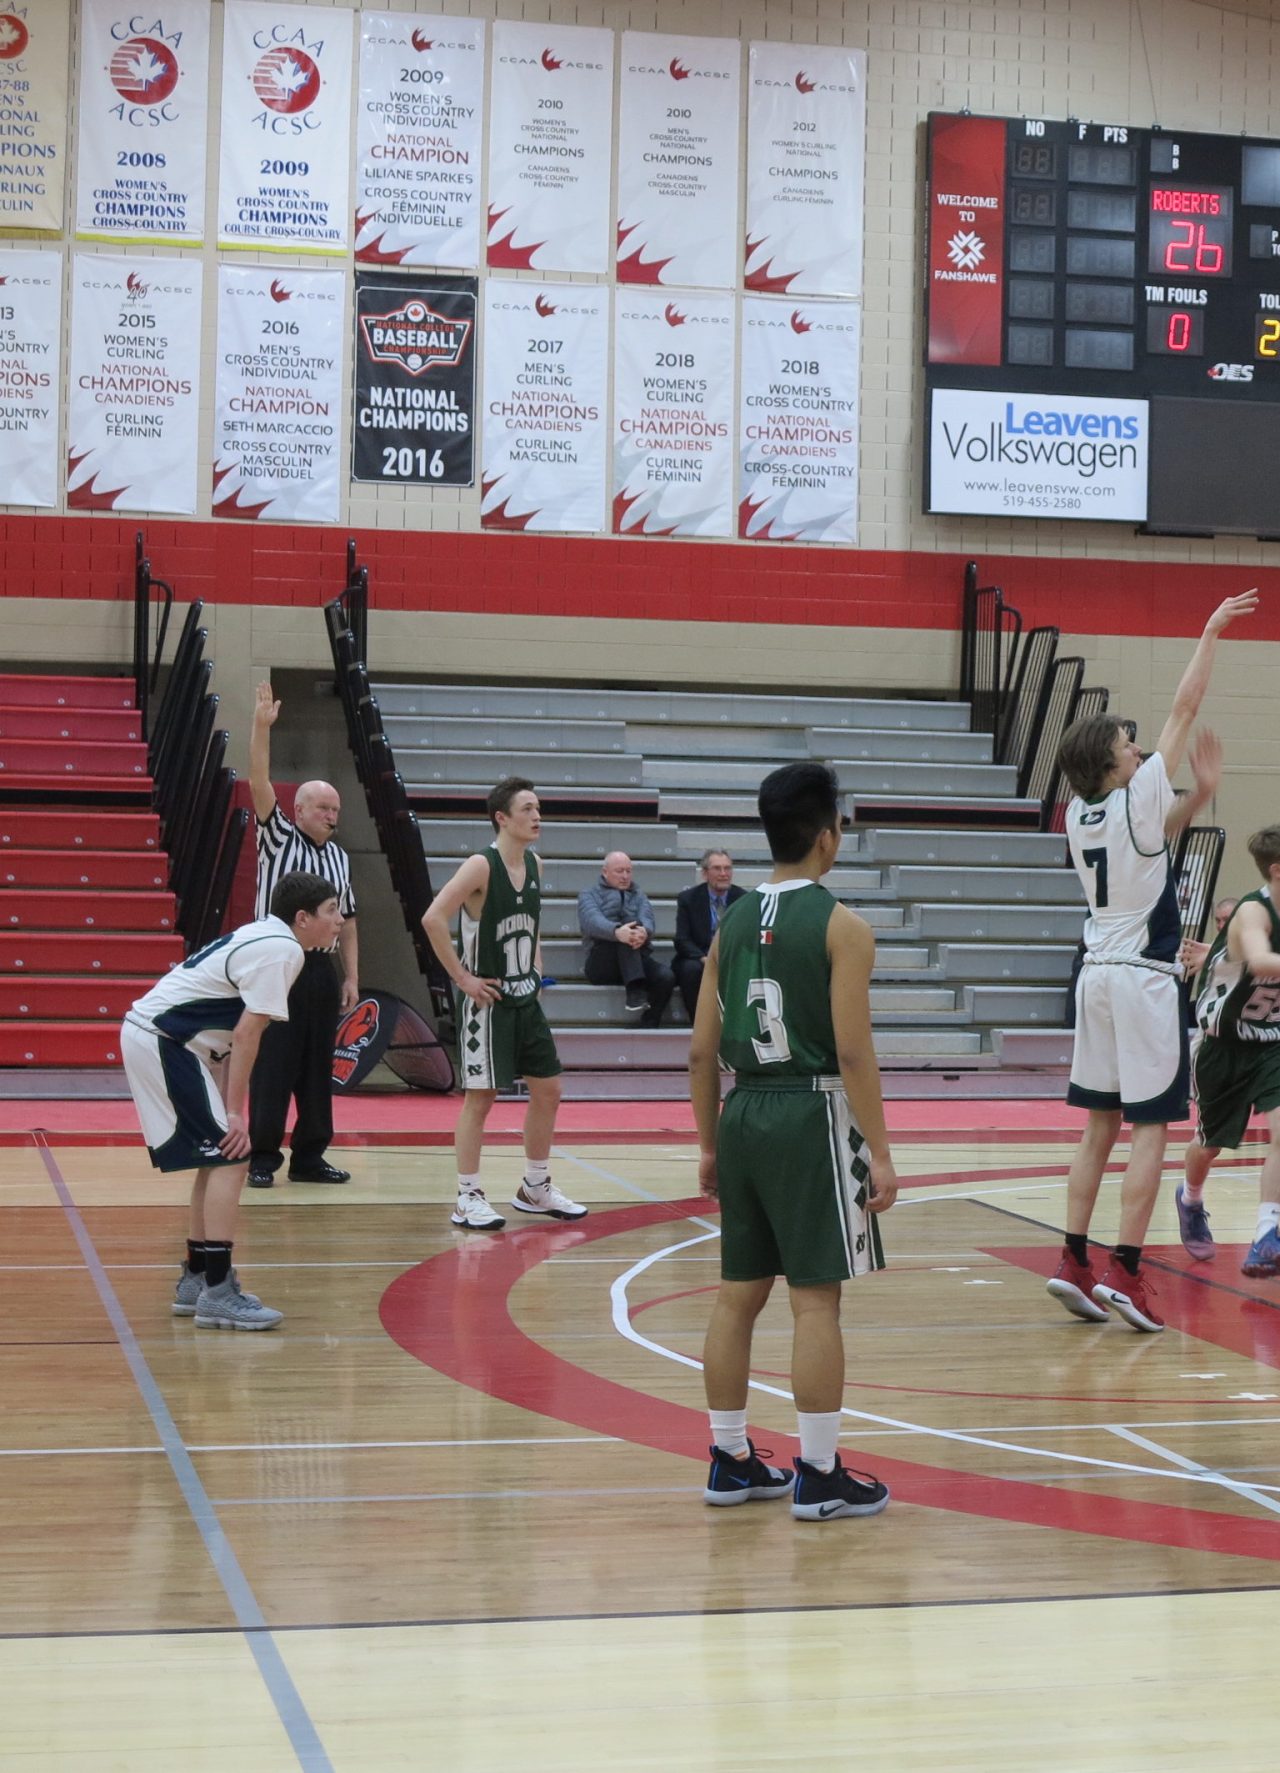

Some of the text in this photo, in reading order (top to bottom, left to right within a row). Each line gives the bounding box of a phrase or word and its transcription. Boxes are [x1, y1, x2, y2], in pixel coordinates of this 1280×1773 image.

[400, 69, 444, 83] 2009
[390, 91, 452, 105] WOMEN'S
[538, 99, 563, 110] 2010
[367, 102, 474, 119] CROSS COUNTRY
[667, 108, 692, 118] 2010
[383, 115, 457, 129] INDIVIDUAL
[792, 122, 816, 132] 2012
[1026, 121, 1045, 137] NO
[1079, 126, 1086, 139] F
[1104, 127, 1128, 143] PTS
[387, 134, 452, 147] NATIONAL
[371, 145, 469, 164] CHAMPION
[514, 144, 585, 158] CHAMPIONS
[1173, 145, 1179, 156] B
[117, 152, 166, 168] 2008
[643, 153, 712, 166] CHAMPIONS
[1173, 158, 1179, 169] B
[260, 160, 309, 176] 2009
[769, 167, 838, 180] CHAMPIONS
[365, 168, 473, 184] LILIANE SPARKES
[115, 179, 166, 191] WOMEN'S
[93, 189, 188, 203] CROSS COUNTRY
[258, 187, 309, 198] WOMEN'S
[365, 188, 472, 203] CROSS COUNTRY
[237, 197, 329, 211] CROSS COUNTRY
[937, 194, 998, 208] WELCOME
[1153, 190, 1220, 215] ROBERTS
[95, 202, 185, 218] CHAMPIONS
[959, 211, 975, 222] TO
[238, 210, 328, 226] CHAMPIONS
[374, 213, 463, 227] INDIVIDUELLE
[1272, 231, 1278, 241] P
[1165, 221, 1224, 273] 26
[934, 270, 996, 283] FANSHAWE
[1145, 286, 1207, 304] TM FOULS
[118, 314, 155, 328] 2015
[262, 320, 299, 334] 2016
[373, 328, 458, 348] BASEBALL
[1168, 314, 1191, 350] 0
[1260, 319, 1280, 356] 2
[104, 334, 168, 347] WOMEN'S
[528, 339, 563, 353] 2017
[107, 347, 164, 360] CURLING
[259, 344, 300, 356] MEN'S
[225, 354, 334, 370] CROSS COUNTRY
[525, 362, 565, 373] MEN'S
[656, 353, 694, 368] 2018
[781, 360, 819, 375] 2018
[102, 364, 168, 377] NATIONAL
[241, 367, 317, 380] INDIVIDUAL
[1214, 363, 1254, 381] OES
[79, 376, 191, 394] CHAMPIONS
[516, 374, 572, 386] CURLING
[643, 378, 707, 390] WOMEN'S
[245, 386, 312, 399] NATIONAL
[370, 386, 459, 410] NATIONAL
[512, 390, 576, 403] NATIONAL
[647, 391, 703, 403] CURLING
[769, 385, 831, 397] WOMEN'S
[95, 392, 174, 406] CANADIENS
[746, 396, 854, 412] CROSS COUNTRY
[229, 398, 328, 416] CHAMPION
[490, 402, 598, 420] CHAMPIONS
[105, 413, 163, 426] CURLING
[360, 408, 468, 432] CHAMPIONS
[641, 409, 707, 420] NATIONAL
[767, 415, 830, 427] NATIONAL
[1007, 402, 1138, 439] Leavens
[223, 421, 333, 435] SETH MARCACCIO
[505, 419, 582, 432] CANADIENS
[620, 420, 728, 436] CHAMPIONS
[746, 426, 852, 443] CHAMPIONS
[223, 440, 331, 456] CROSS COUNTRY
[516, 439, 571, 450] CURLING
[636, 438, 712, 451] CANADIENS
[761, 445, 837, 457] CANADIENS
[943, 422, 1136, 477] Volkswagen
[243, 455, 312, 468] MASCULIN
[382, 447, 444, 477] 2016
[510, 452, 577, 463] MASCULIN
[646, 457, 703, 469] CURLING
[239, 466, 314, 480] INDIVIDUEL
[744, 463, 854, 476] CROSS-COUNTRY
[964, 478, 1116, 496] www.leavensvw.com
[1003, 496, 1081, 509] 519-455-2580
[1082, 847, 1108, 908] 7
[504, 936, 532, 977] 10
[746, 978, 792, 1064] 3
